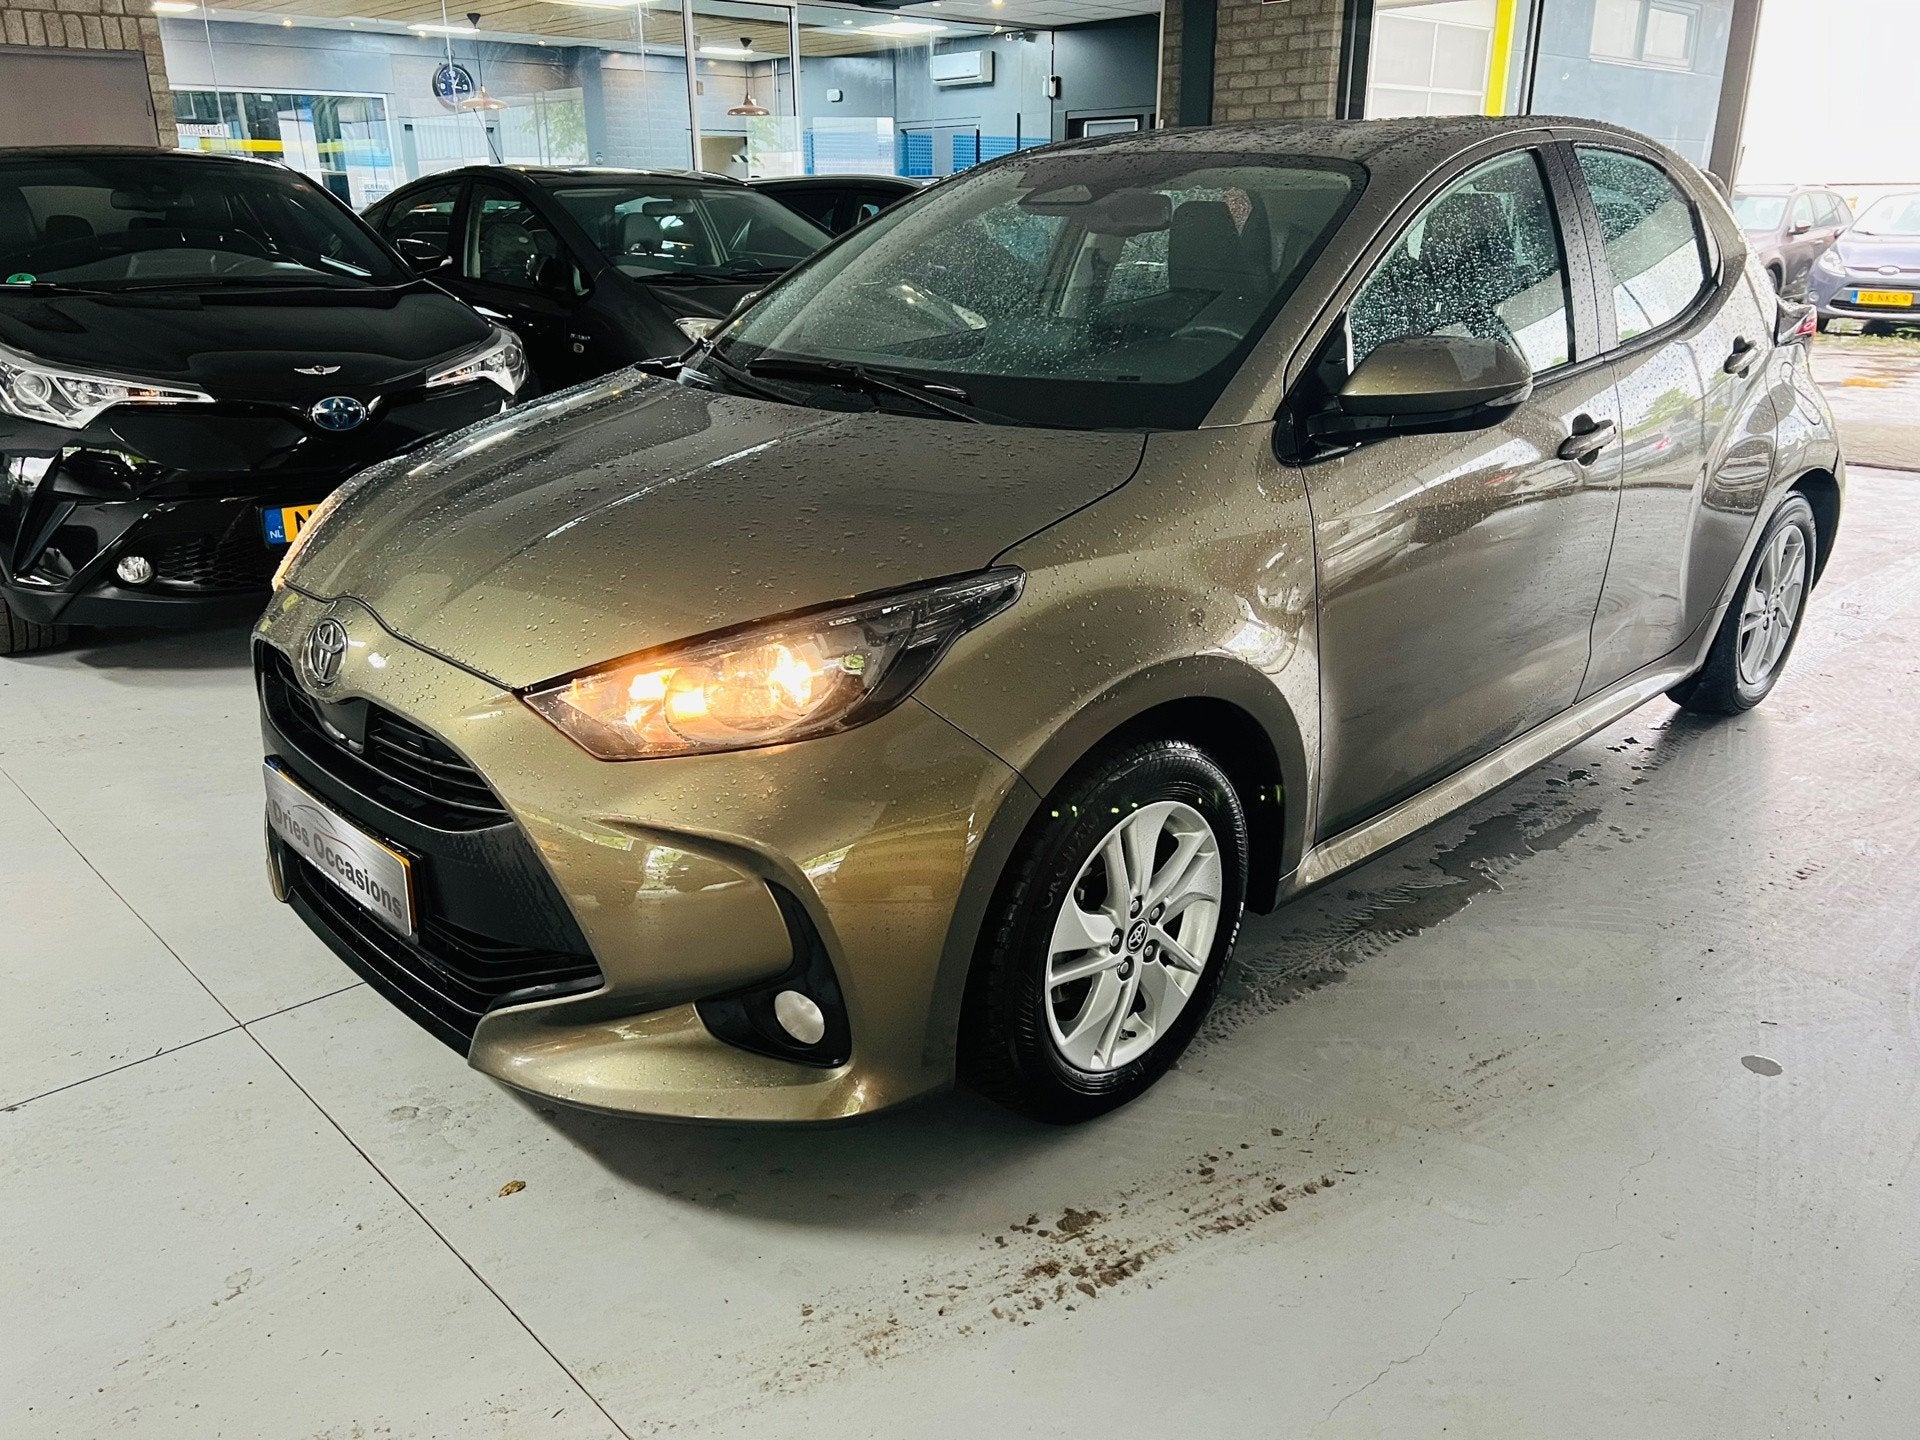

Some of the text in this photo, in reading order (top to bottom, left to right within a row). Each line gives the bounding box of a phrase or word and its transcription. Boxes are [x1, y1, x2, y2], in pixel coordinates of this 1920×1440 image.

[269, 530, 284, 539] NL
[271, 798, 403, 920] Dries Occasions
